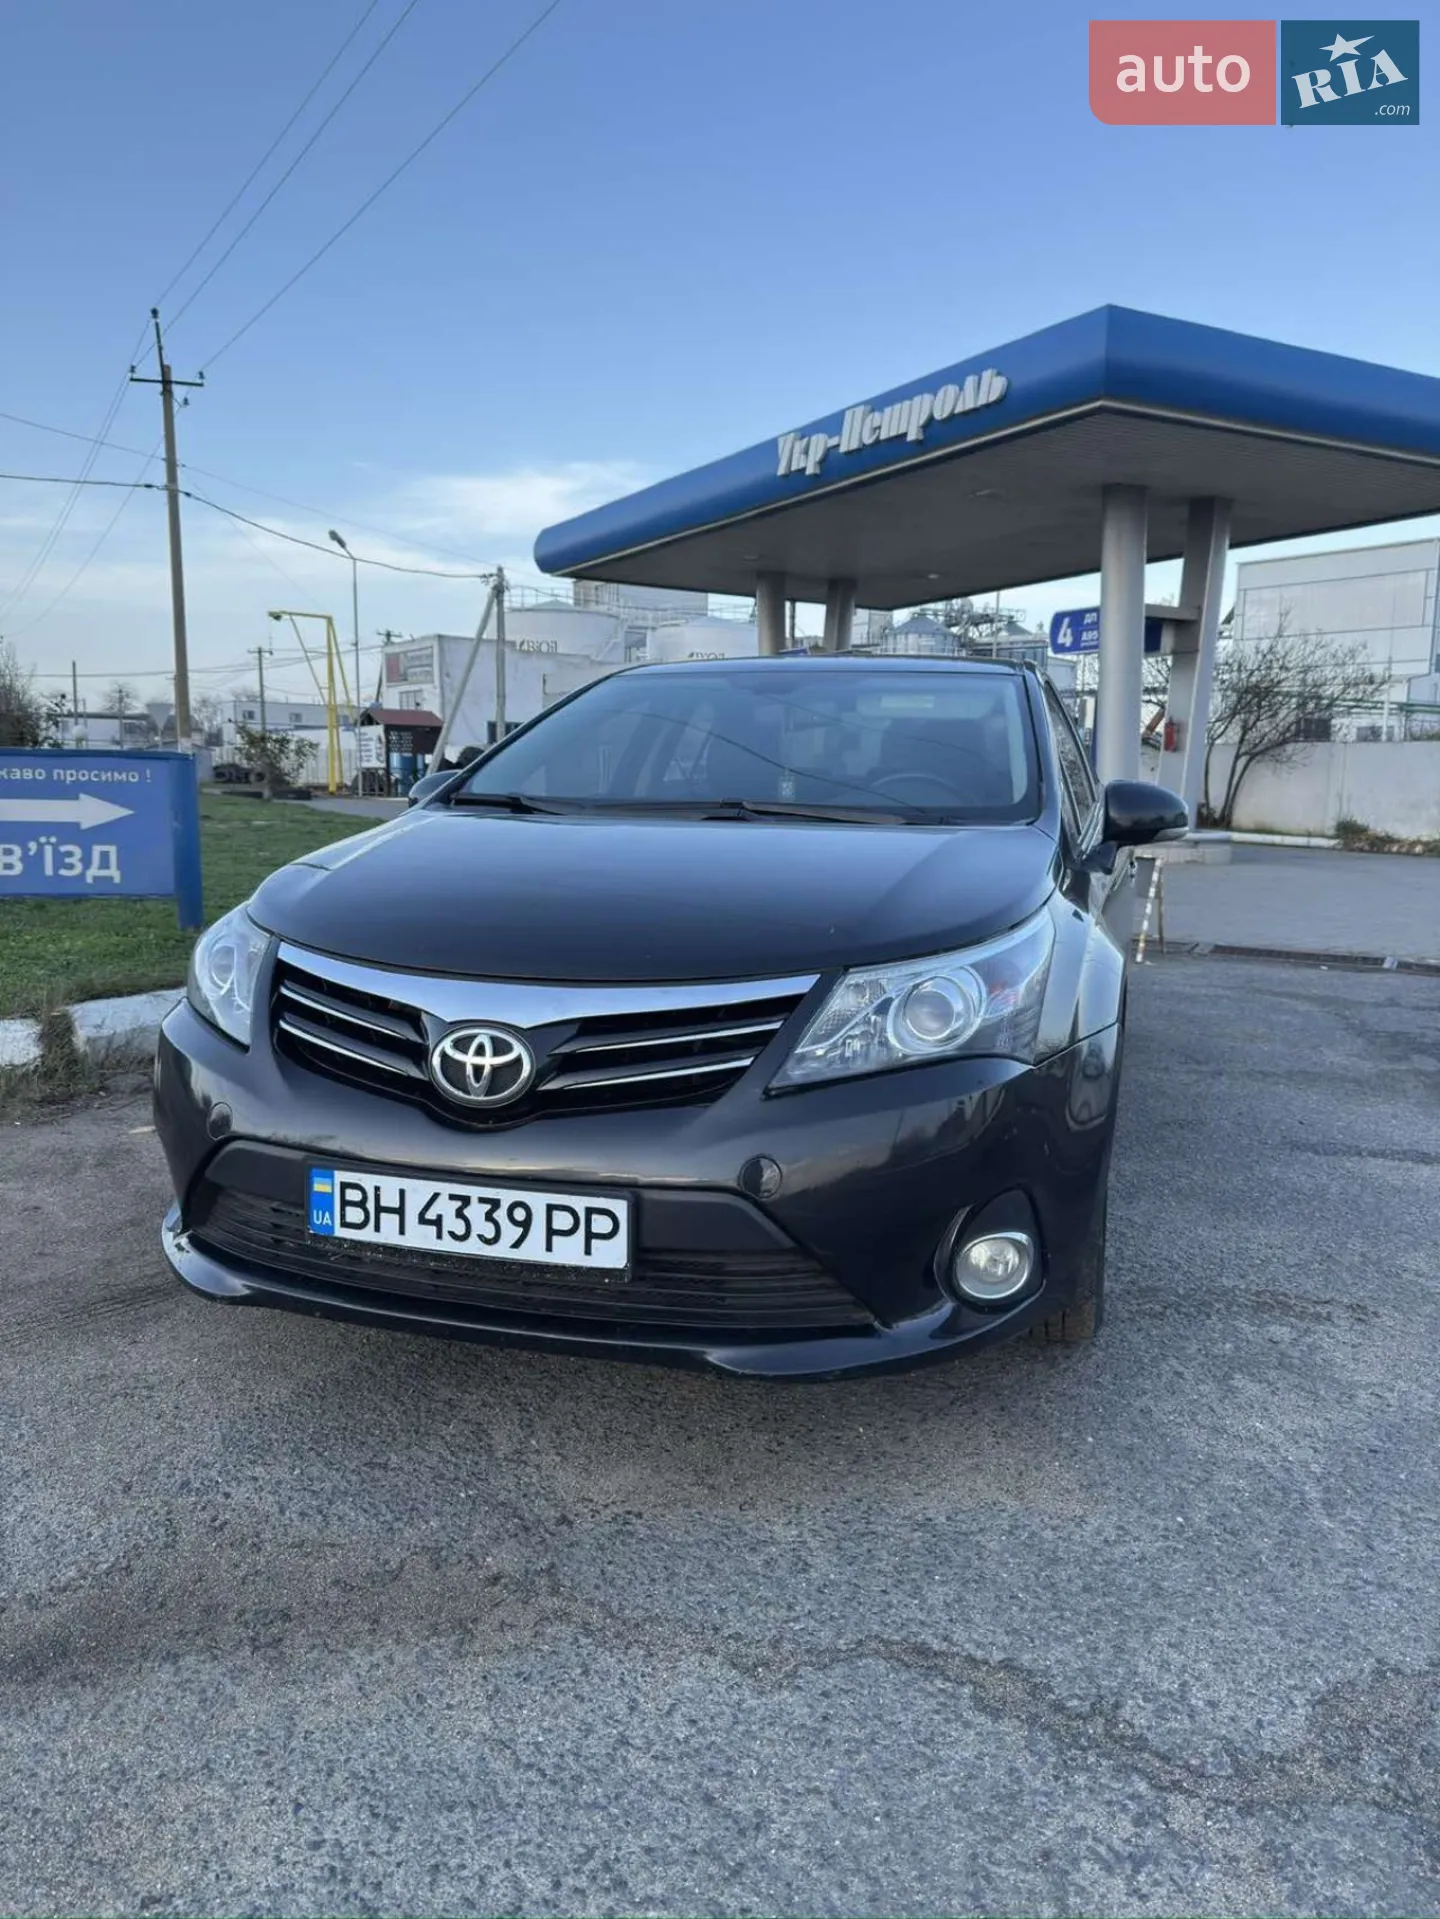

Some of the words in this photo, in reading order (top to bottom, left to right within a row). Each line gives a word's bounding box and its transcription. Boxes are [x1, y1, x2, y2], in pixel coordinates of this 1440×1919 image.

[1057, 617, 1073, 647] 4
[53, 768, 139, 784] просимо
[313, 1210, 332, 1226] UA
[339, 1181, 406, 1236] BH
[418, 1192, 533, 1249] 4339
[545, 1203, 620, 1256] PP
